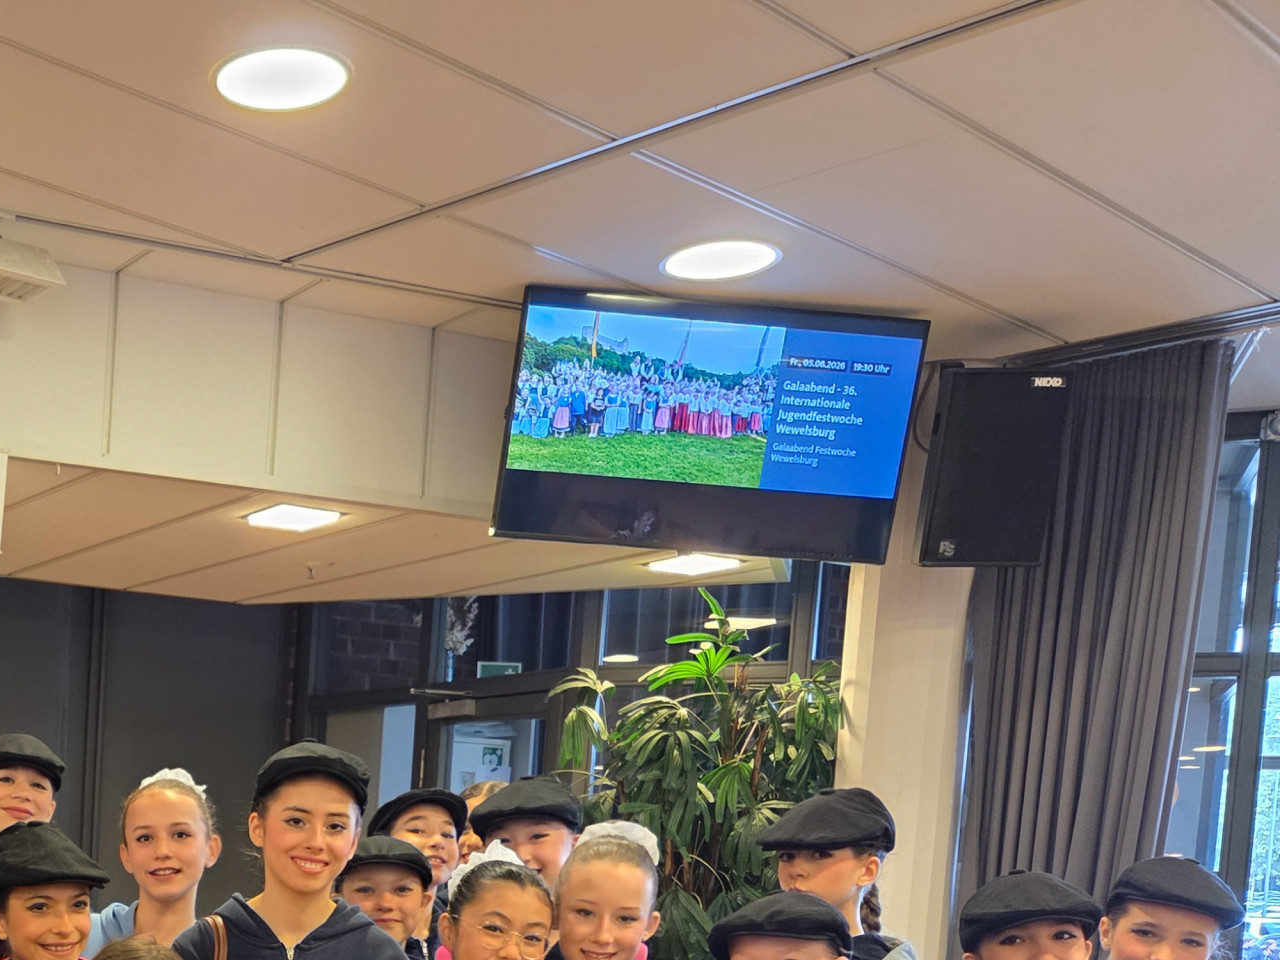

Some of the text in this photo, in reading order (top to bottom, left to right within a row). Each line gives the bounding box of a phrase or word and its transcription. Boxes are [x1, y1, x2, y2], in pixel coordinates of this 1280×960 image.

[853, 363, 873, 372] 19:30
[874, 364, 890, 374] Uhr
[783, 380, 836, 394] Galaabend
[843, 385, 857, 396] 36.
[1034, 377, 1063, 387] NEXO
[780, 395, 851, 410] Internationale
[777, 409, 863, 426] Jugendfestwoche
[775, 424, 836, 440] Wewelsburg
[772, 442, 857, 457] Galaabend Festwoche
[771, 453, 819, 468] Wewelsburg
